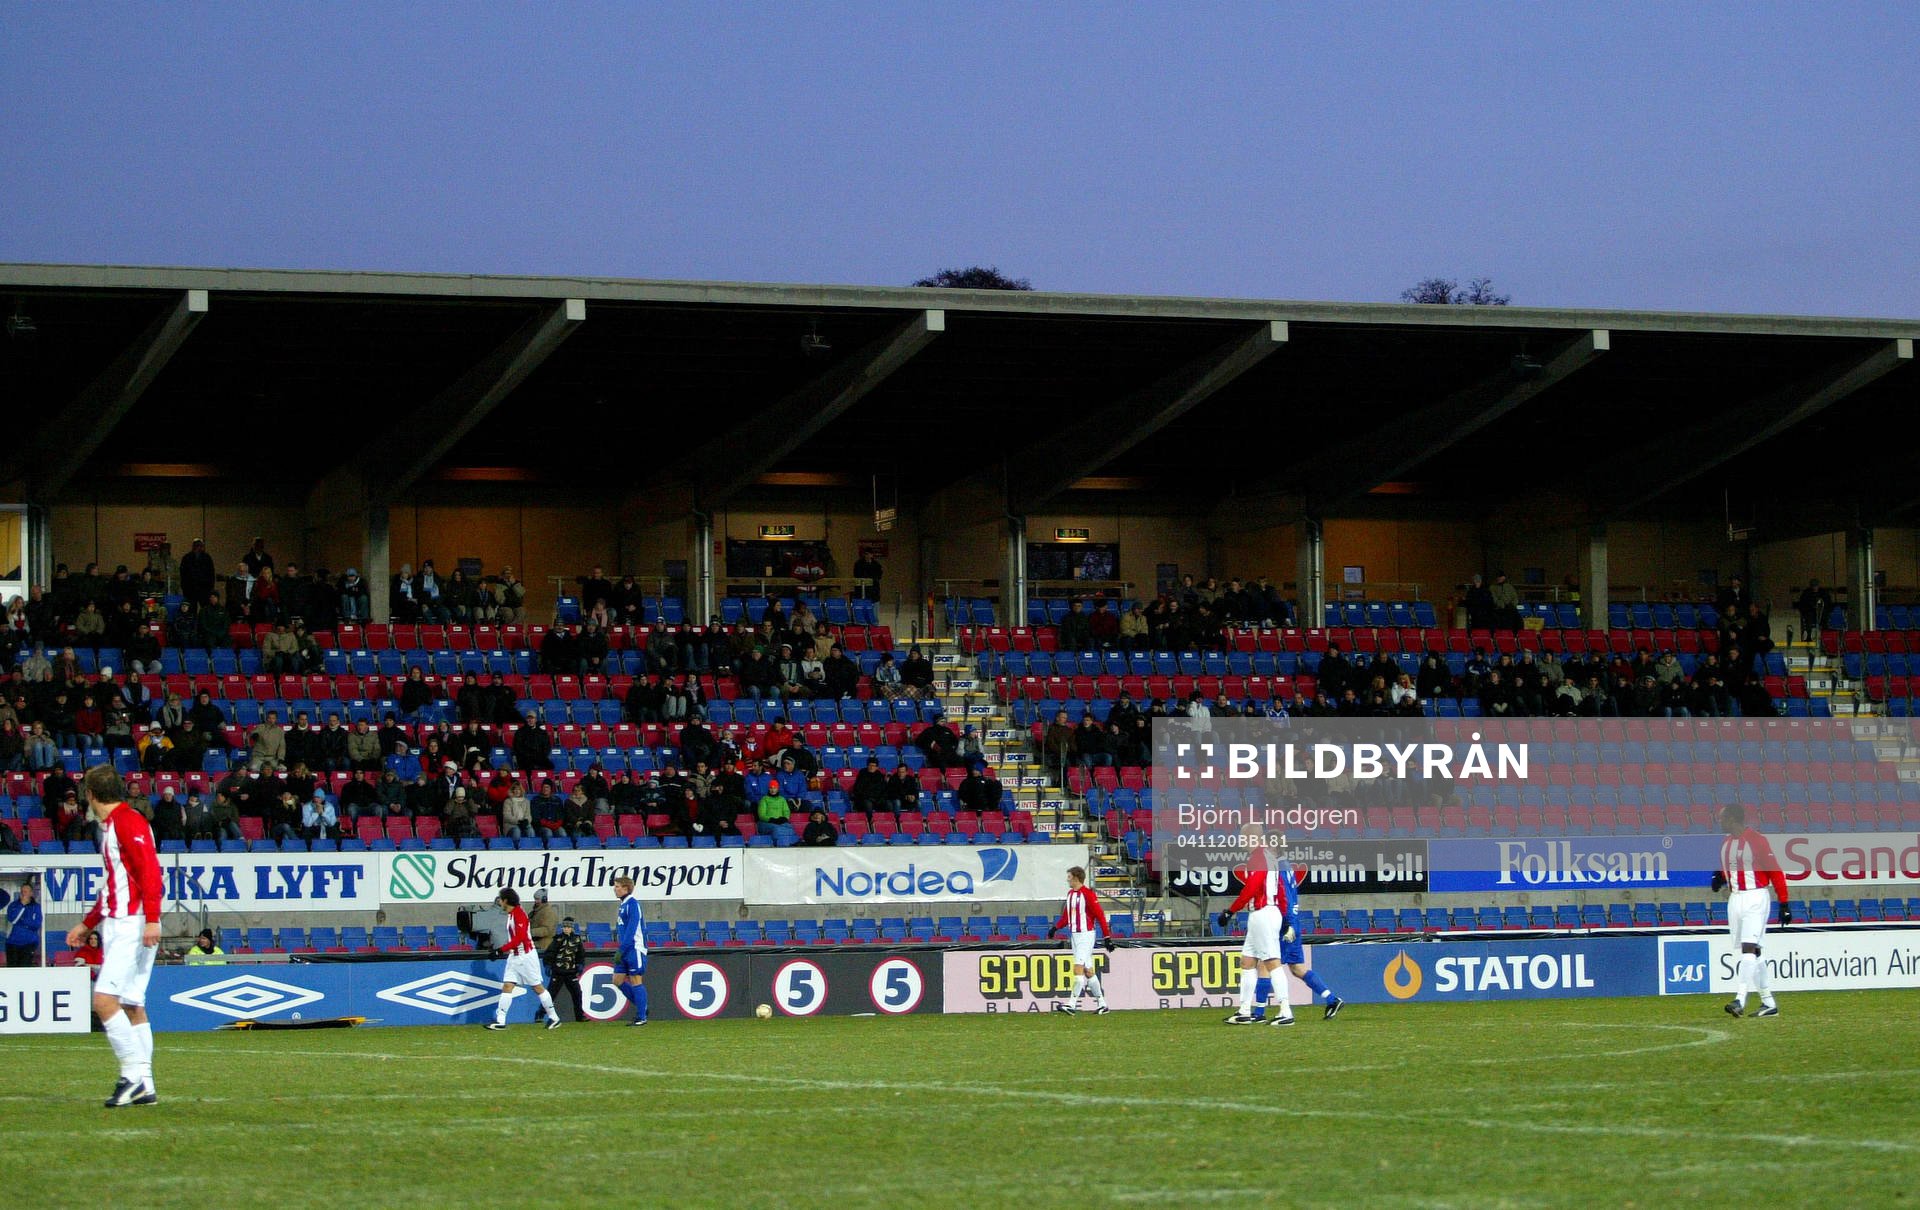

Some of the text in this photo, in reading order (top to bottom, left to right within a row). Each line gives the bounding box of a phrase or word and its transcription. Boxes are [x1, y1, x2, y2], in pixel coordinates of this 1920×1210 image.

[255, 865, 364, 900] LYFT
[816, 864, 974, 897] Nordea
[1311, 855, 1366, 883] min
[1377, 853, 1423, 882] bil!
[1435, 953, 1594, 991] STATOIL
[1668, 963, 1706, 982] SAS
[1720, 949, 1877, 981] Sndinavian
[589, 973, 617, 1012] 5
[689, 971, 716, 1009] 5
[788, 969, 815, 1007] 5
[884, 968, 911, 1005] 5
